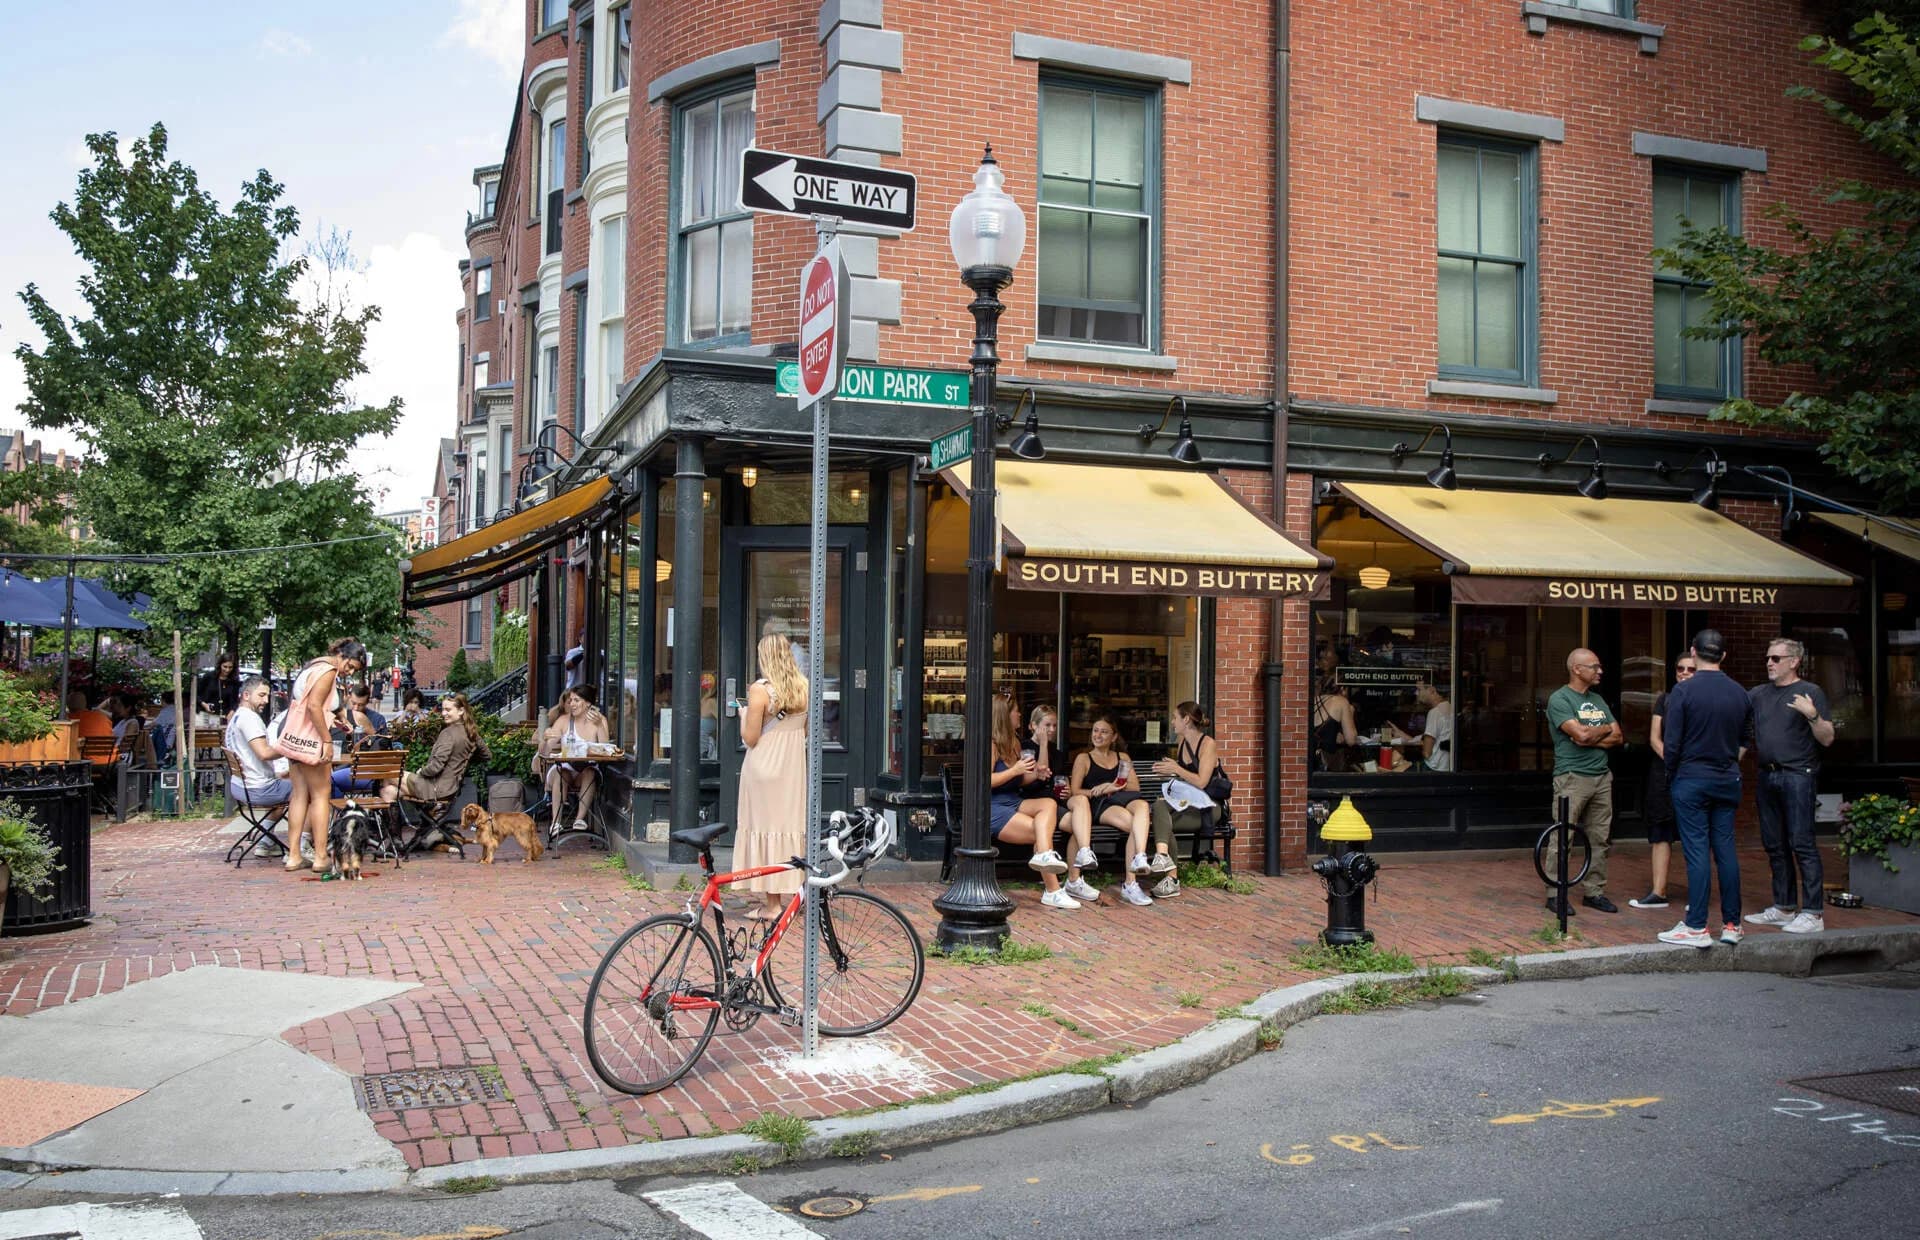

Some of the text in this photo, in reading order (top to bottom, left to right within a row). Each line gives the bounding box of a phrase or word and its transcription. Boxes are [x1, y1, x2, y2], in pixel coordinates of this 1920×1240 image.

[794, 175, 898, 210] ONE WAY
[804, 279, 832, 318] DO NOT
[805, 337, 828, 370] ENTER
[883, 371, 932, 400] PARK
[945, 384, 960, 401] ST
[940, 430, 970, 463] SHAWMUT
[1021, 562, 1318, 592] SOUTH END BUTTERY
[1549, 582, 1778, 604] SOUTH END BUTTERY
[283, 733, 318, 749] LICENSE
